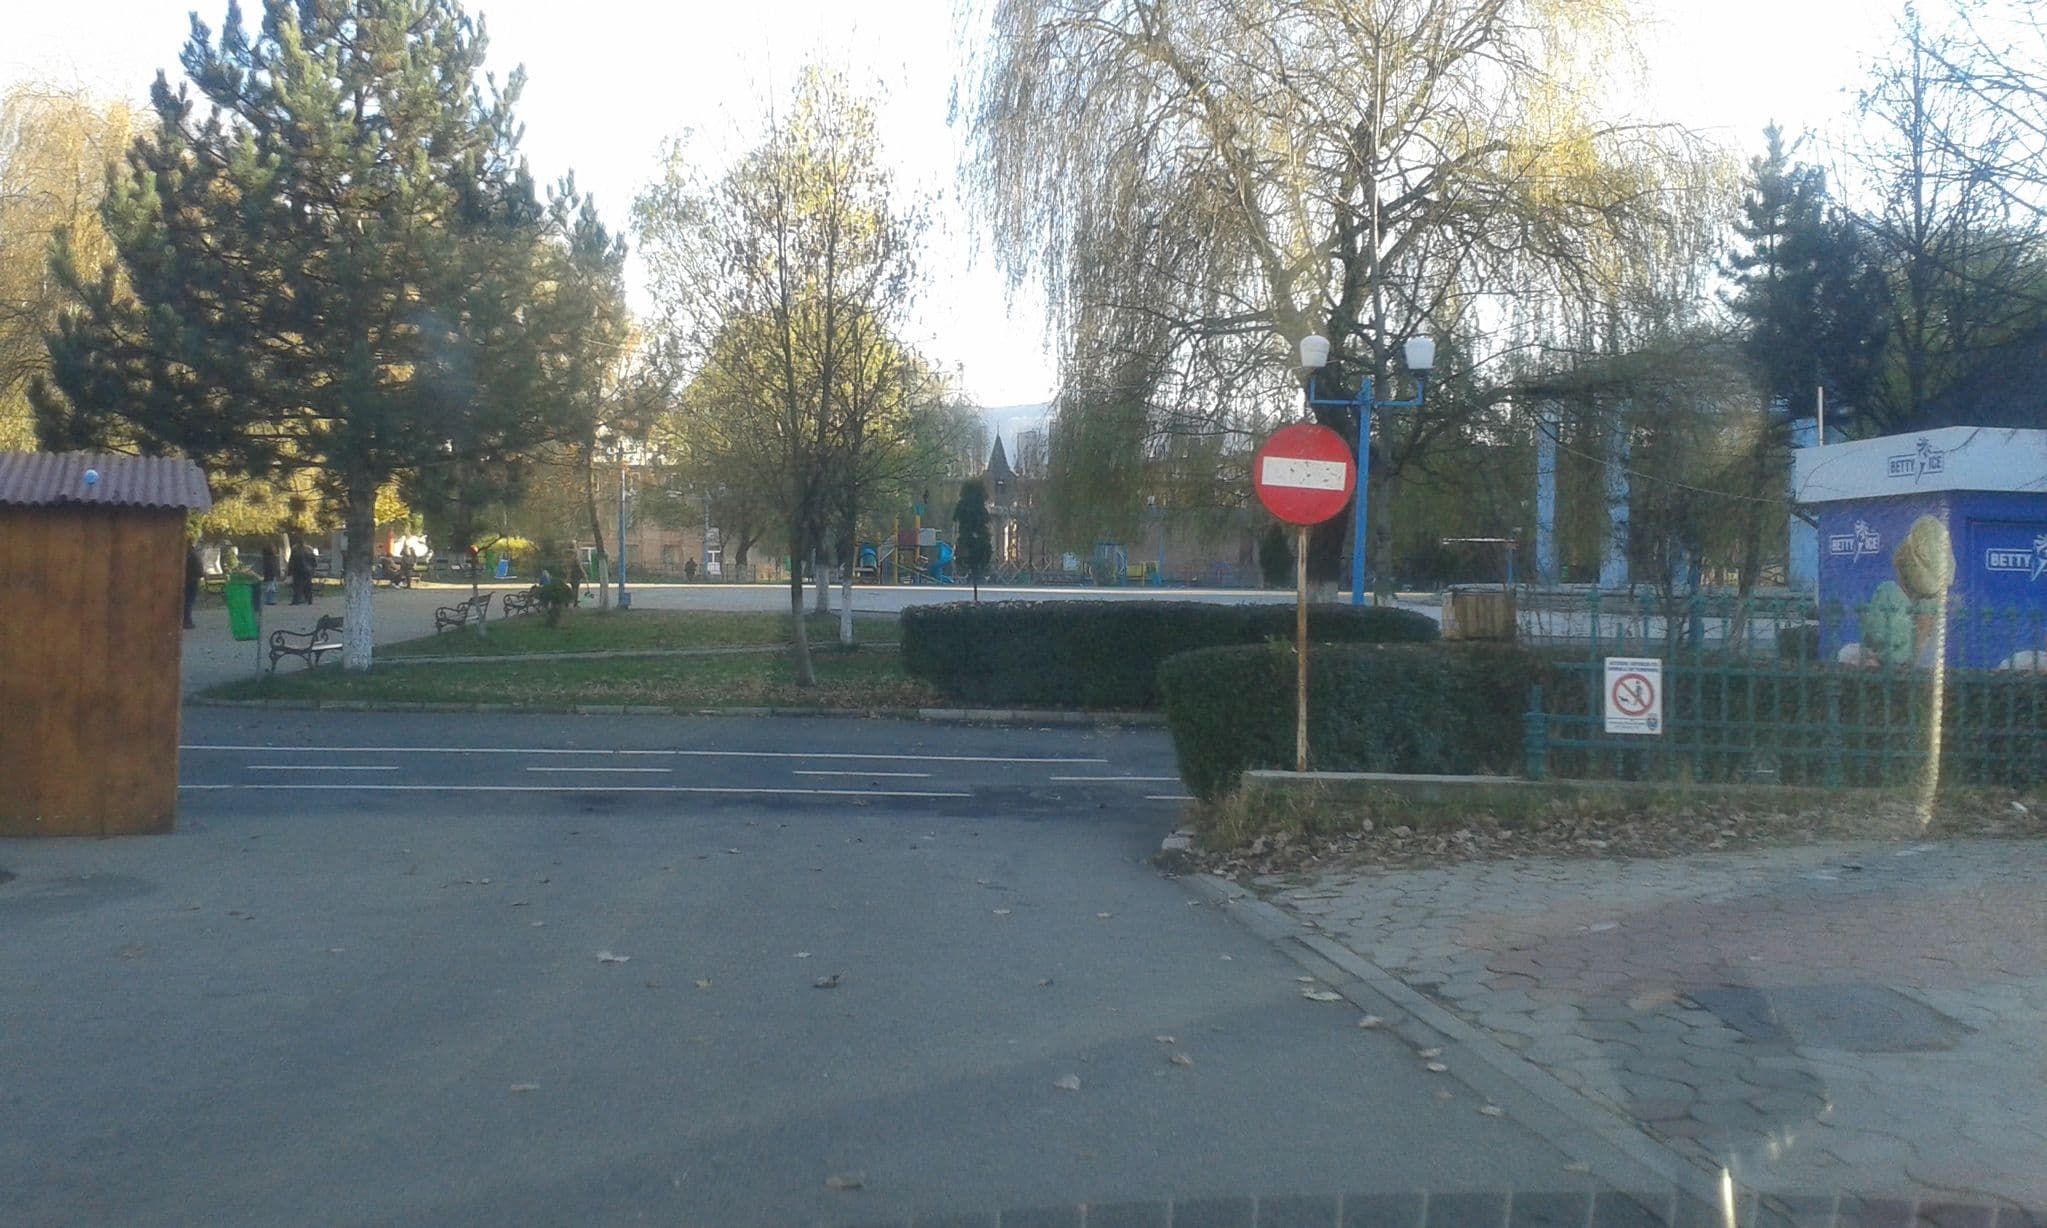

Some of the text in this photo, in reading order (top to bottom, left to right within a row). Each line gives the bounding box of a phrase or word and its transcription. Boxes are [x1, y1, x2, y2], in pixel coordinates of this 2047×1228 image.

[1890, 456, 1942, 473] BETTY ICE
[1831, 536, 1878, 552] BETTY ICE
[1990, 553, 2031, 567] BETTY
